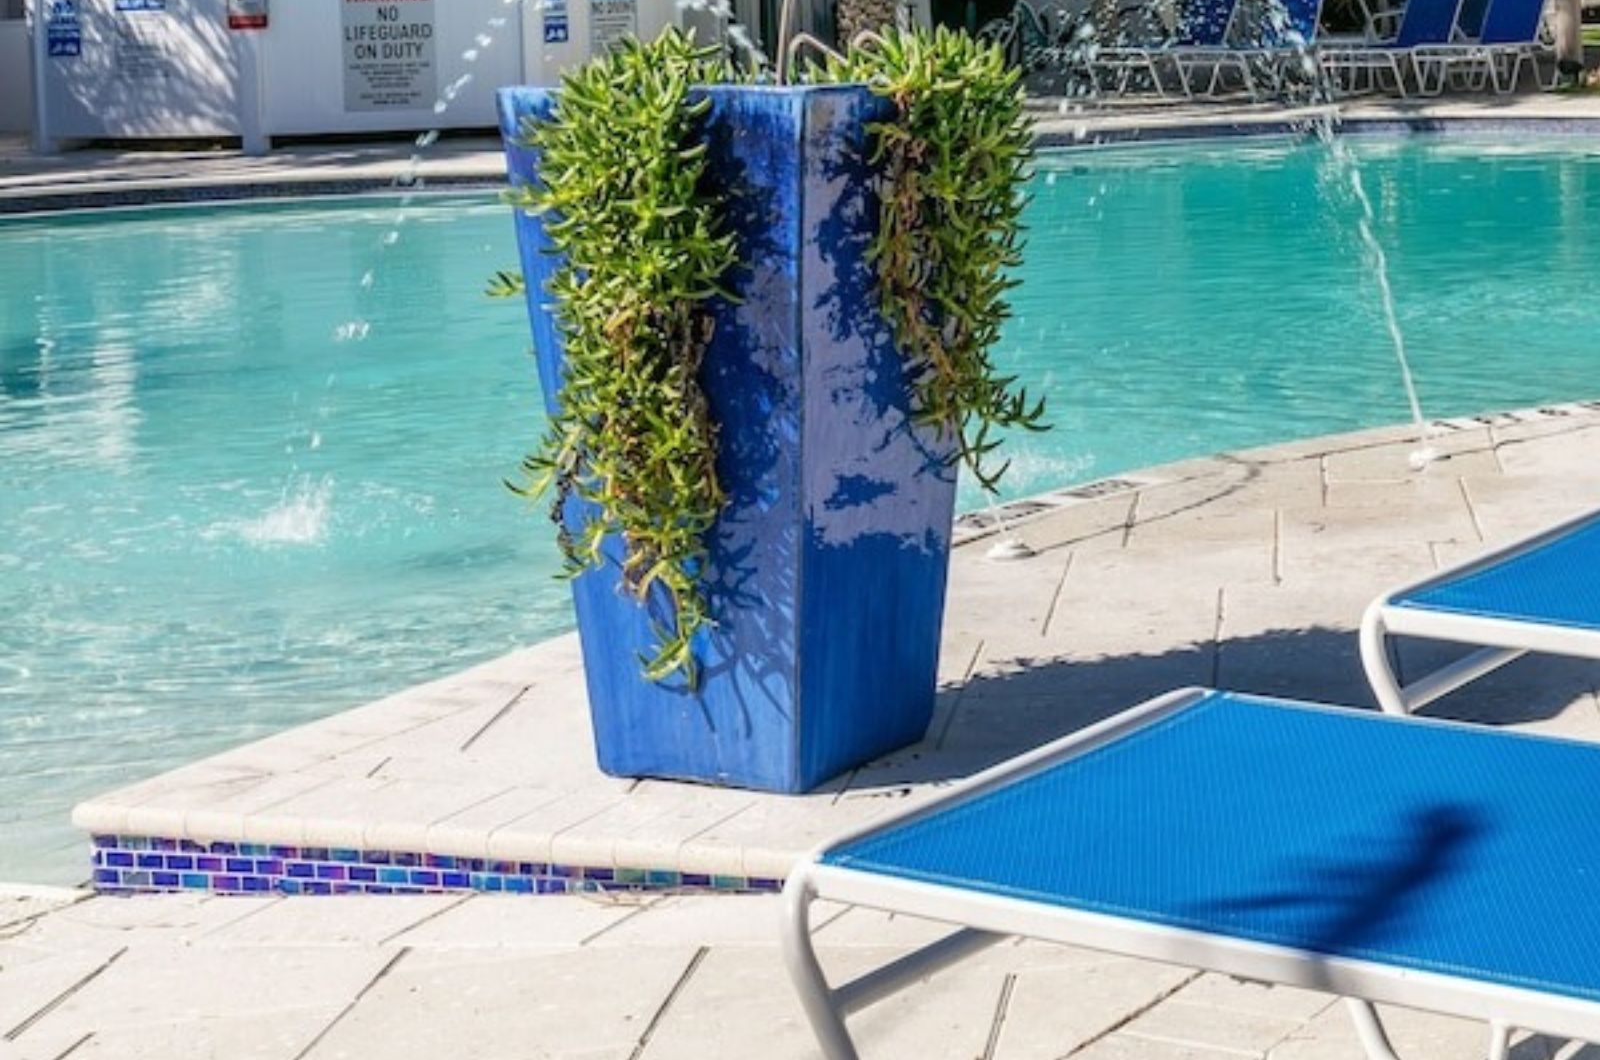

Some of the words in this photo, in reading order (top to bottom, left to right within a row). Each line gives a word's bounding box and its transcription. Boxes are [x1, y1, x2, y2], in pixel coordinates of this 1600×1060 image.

[378, 5, 398, 21] NO
[345, 23, 433, 41] LIFEGUARD
[354, 43, 377, 59] ON
[382, 42, 423, 58] DUTY
